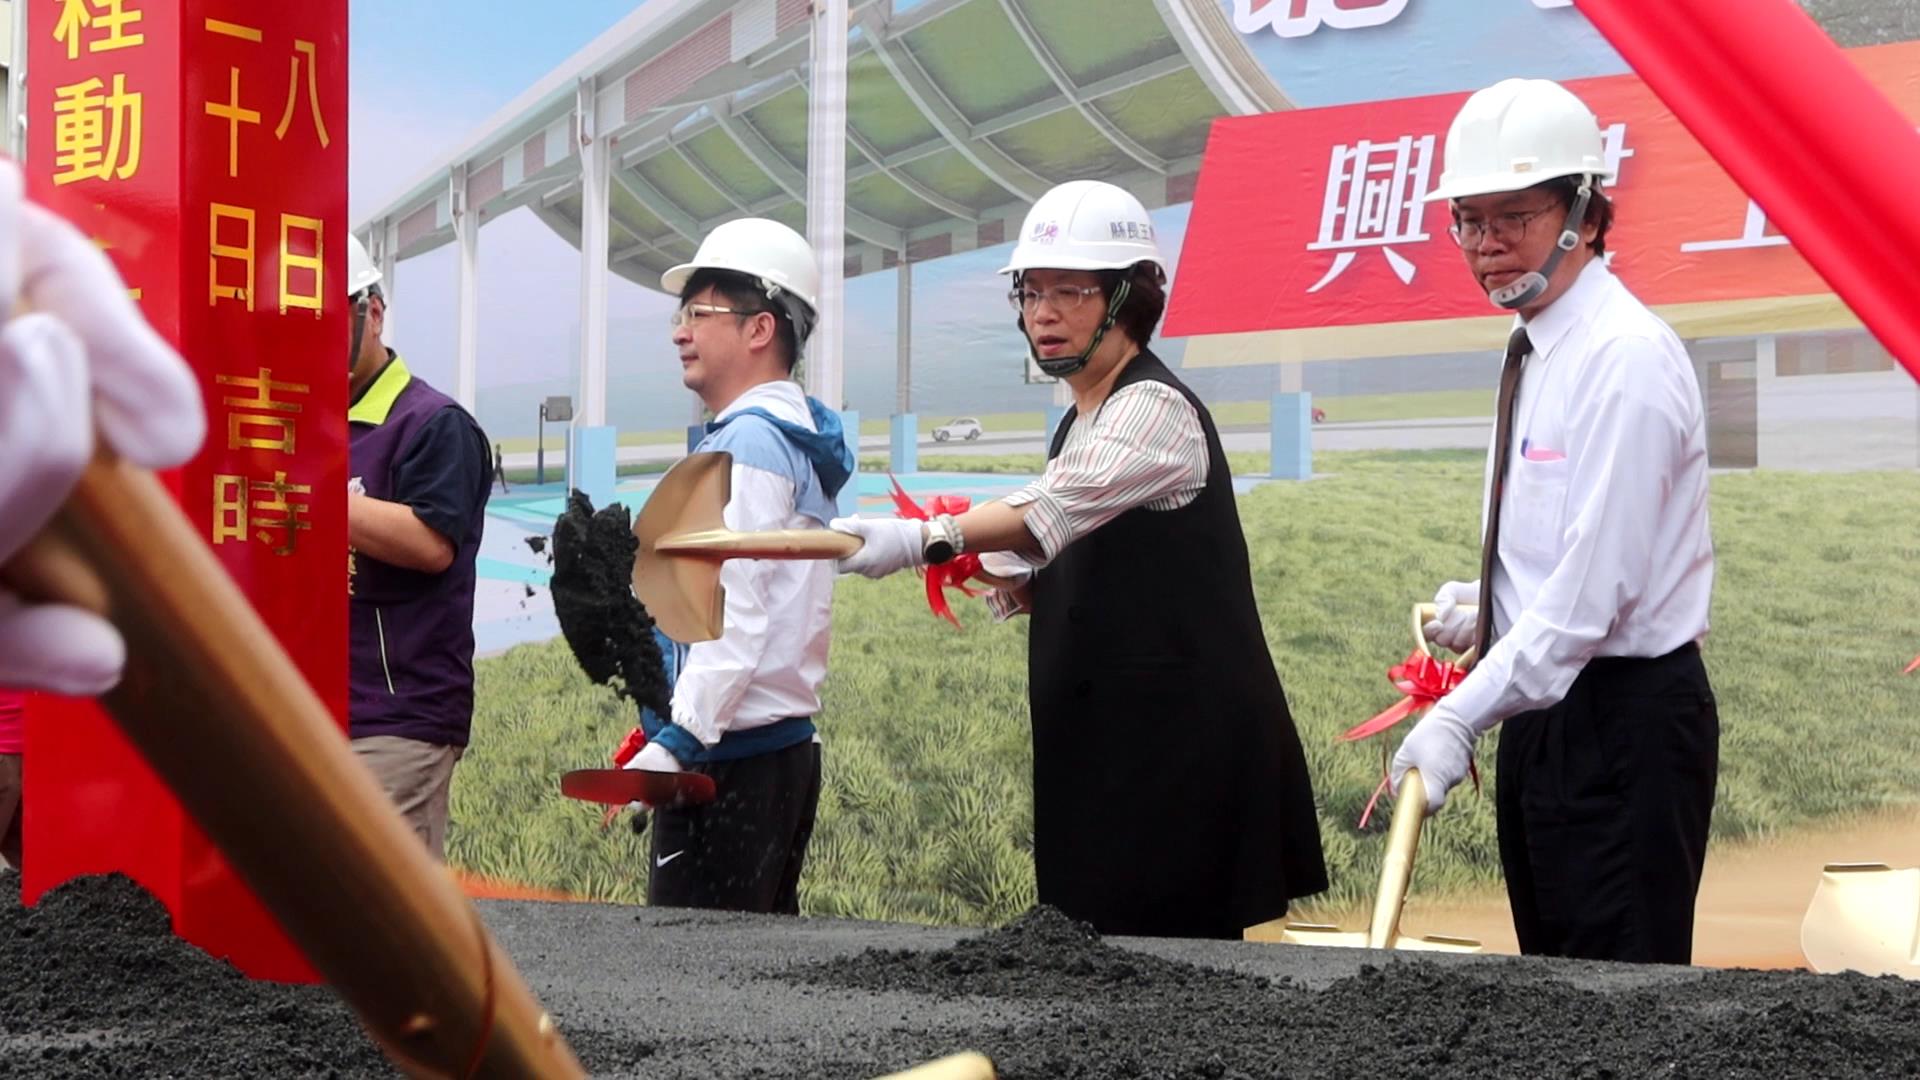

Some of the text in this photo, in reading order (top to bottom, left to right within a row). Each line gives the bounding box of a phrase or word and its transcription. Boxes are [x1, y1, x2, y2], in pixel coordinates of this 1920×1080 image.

[1110, 221, 1155, 240] 縣長王
[213, 366, 312, 557] 吉時
